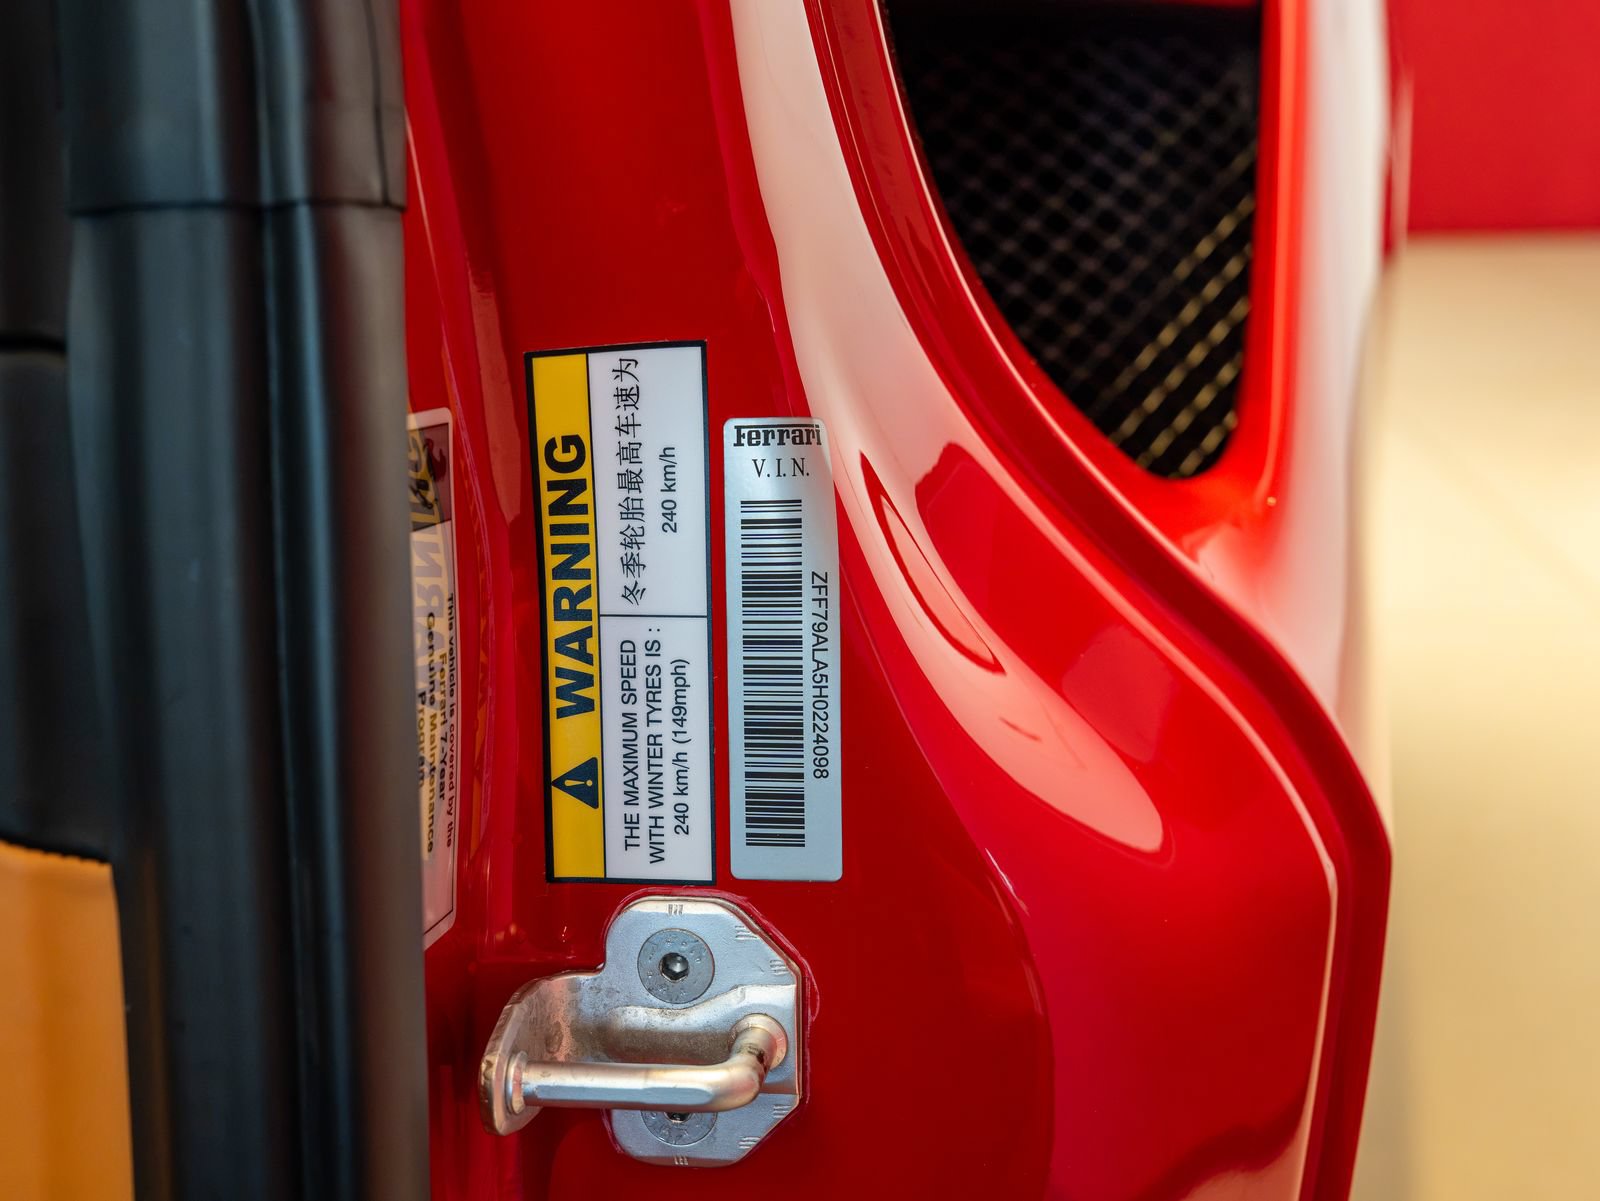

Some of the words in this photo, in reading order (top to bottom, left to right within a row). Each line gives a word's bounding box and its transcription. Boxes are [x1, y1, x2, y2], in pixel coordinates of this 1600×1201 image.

[733, 424, 822, 447] Ferrari
[612, 358, 647, 606] 冬季轮胎最高车速为
[659, 446, 678, 493] km/h
[661, 499, 678, 534] 240
[544, 434, 595, 720] WARNING
[427, 612, 436, 706] Genuine
[620, 639, 637, 705] SPEED
[644, 638, 661, 657] IS
[811, 571, 829, 779] ZFF79ALA5H0224098
[439, 652, 448, 726] Ferrari
[449, 703, 456, 718] is
[645, 664, 663, 728] TYRES
[670, 658, 692, 745] (149mph)
[427, 712, 437, 853] Maintenance
[439, 732, 448, 800] 7-Year
[622, 712, 640, 806] MAXIMUM
[647, 733, 665, 809] WINTER
[672, 751, 690, 797] km/h
[446, 795, 455, 816] by
[446, 821, 454, 848] the
[624, 812, 640, 851] THE
[673, 802, 690, 836] 240
[649, 815, 665, 864] WITH
